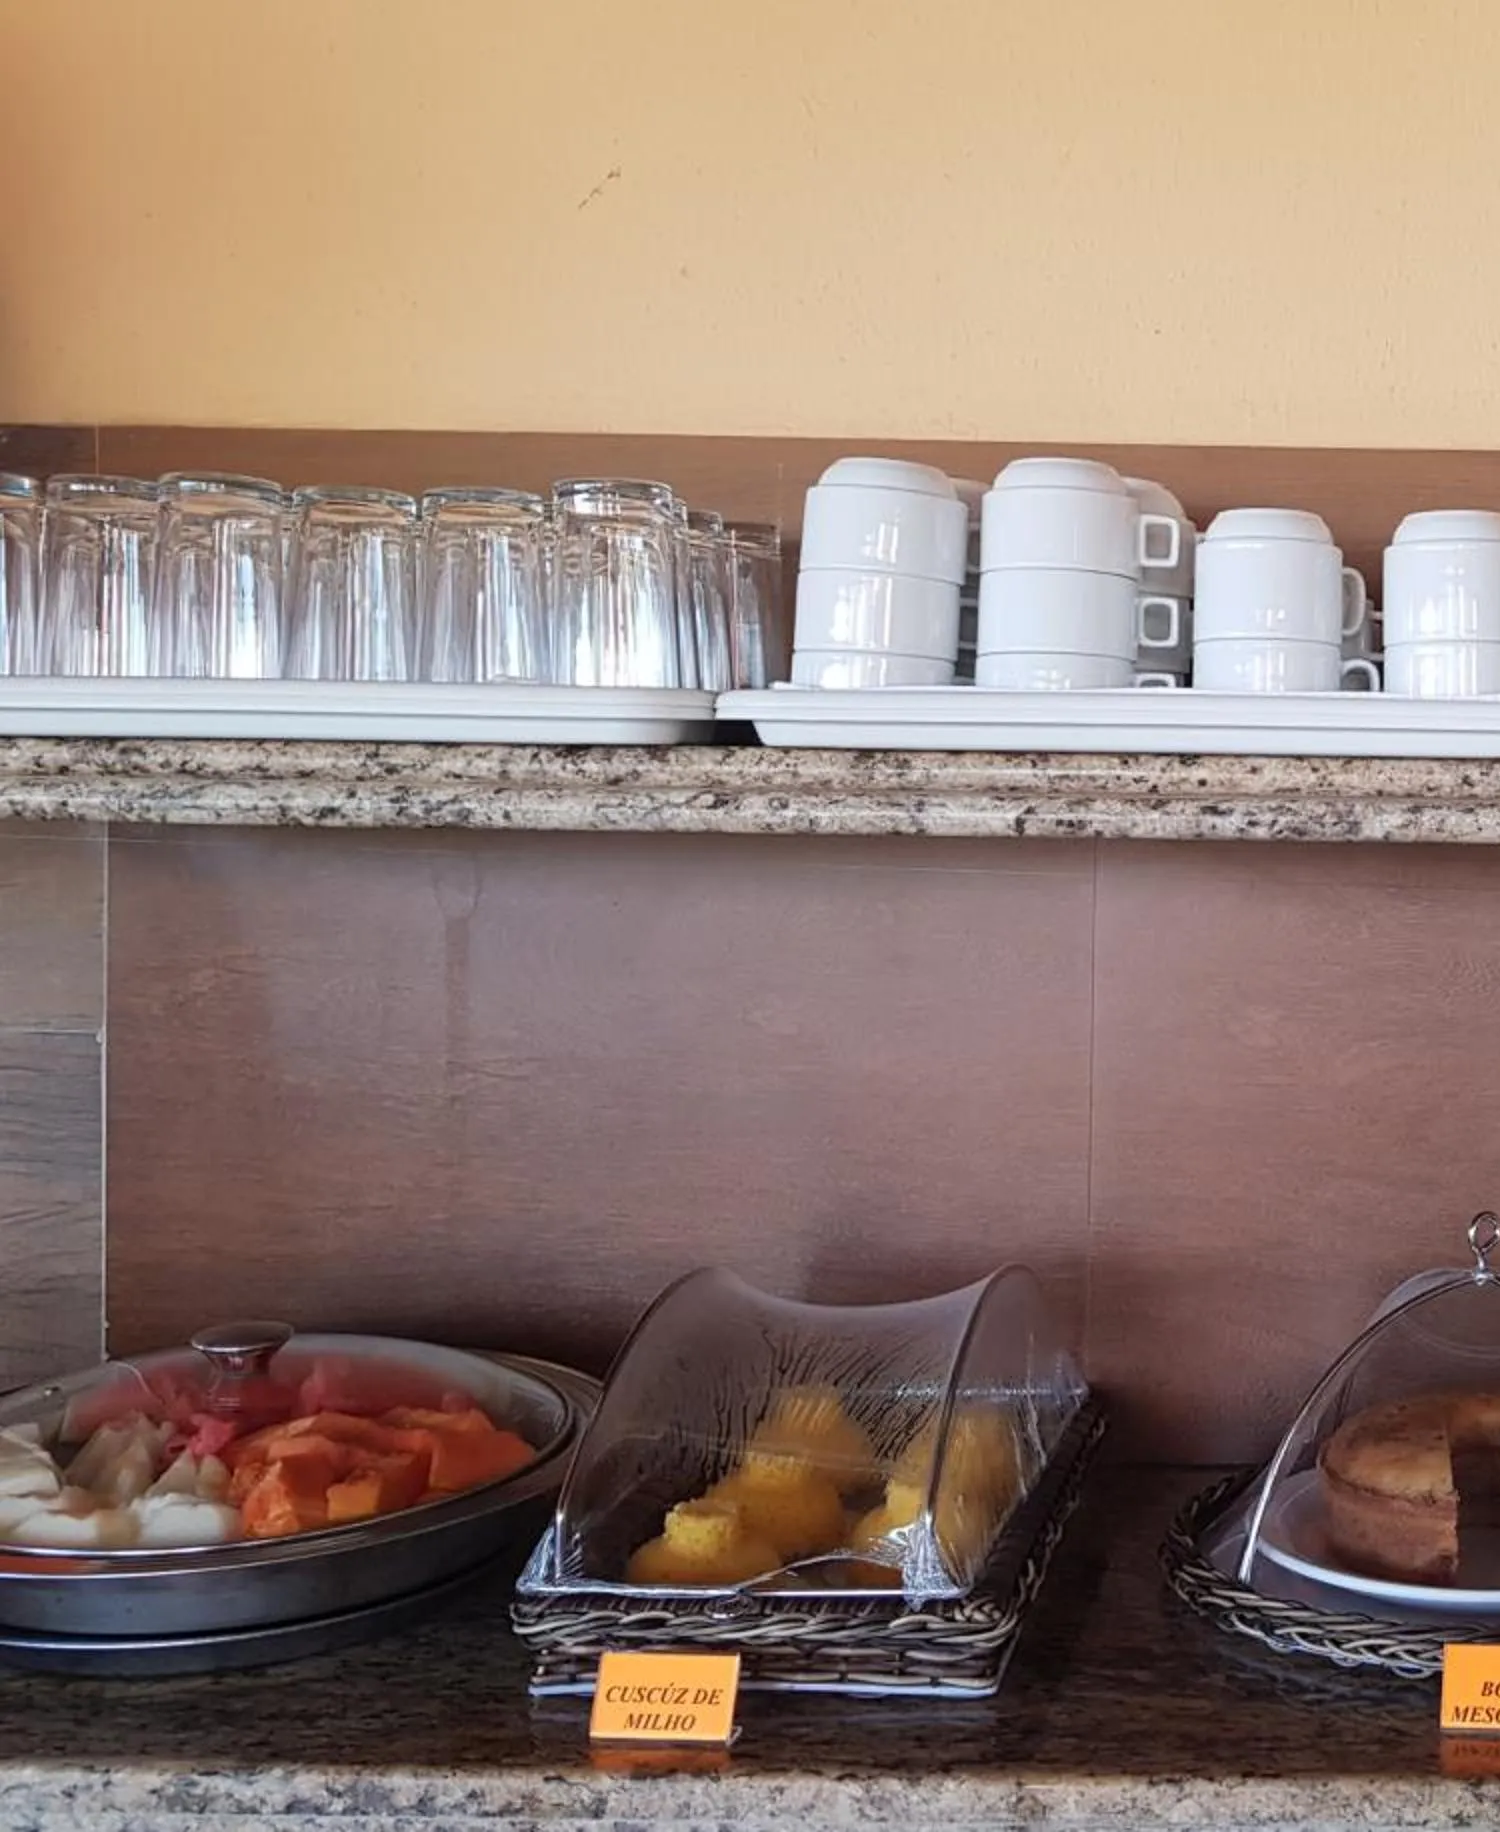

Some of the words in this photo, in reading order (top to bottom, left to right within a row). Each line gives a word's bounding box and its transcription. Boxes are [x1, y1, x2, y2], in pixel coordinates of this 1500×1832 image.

[605, 1682, 689, 1705] CUSCÚZ
[693, 1688, 724, 1705] DE
[624, 1713, 697, 1731] MILHO
